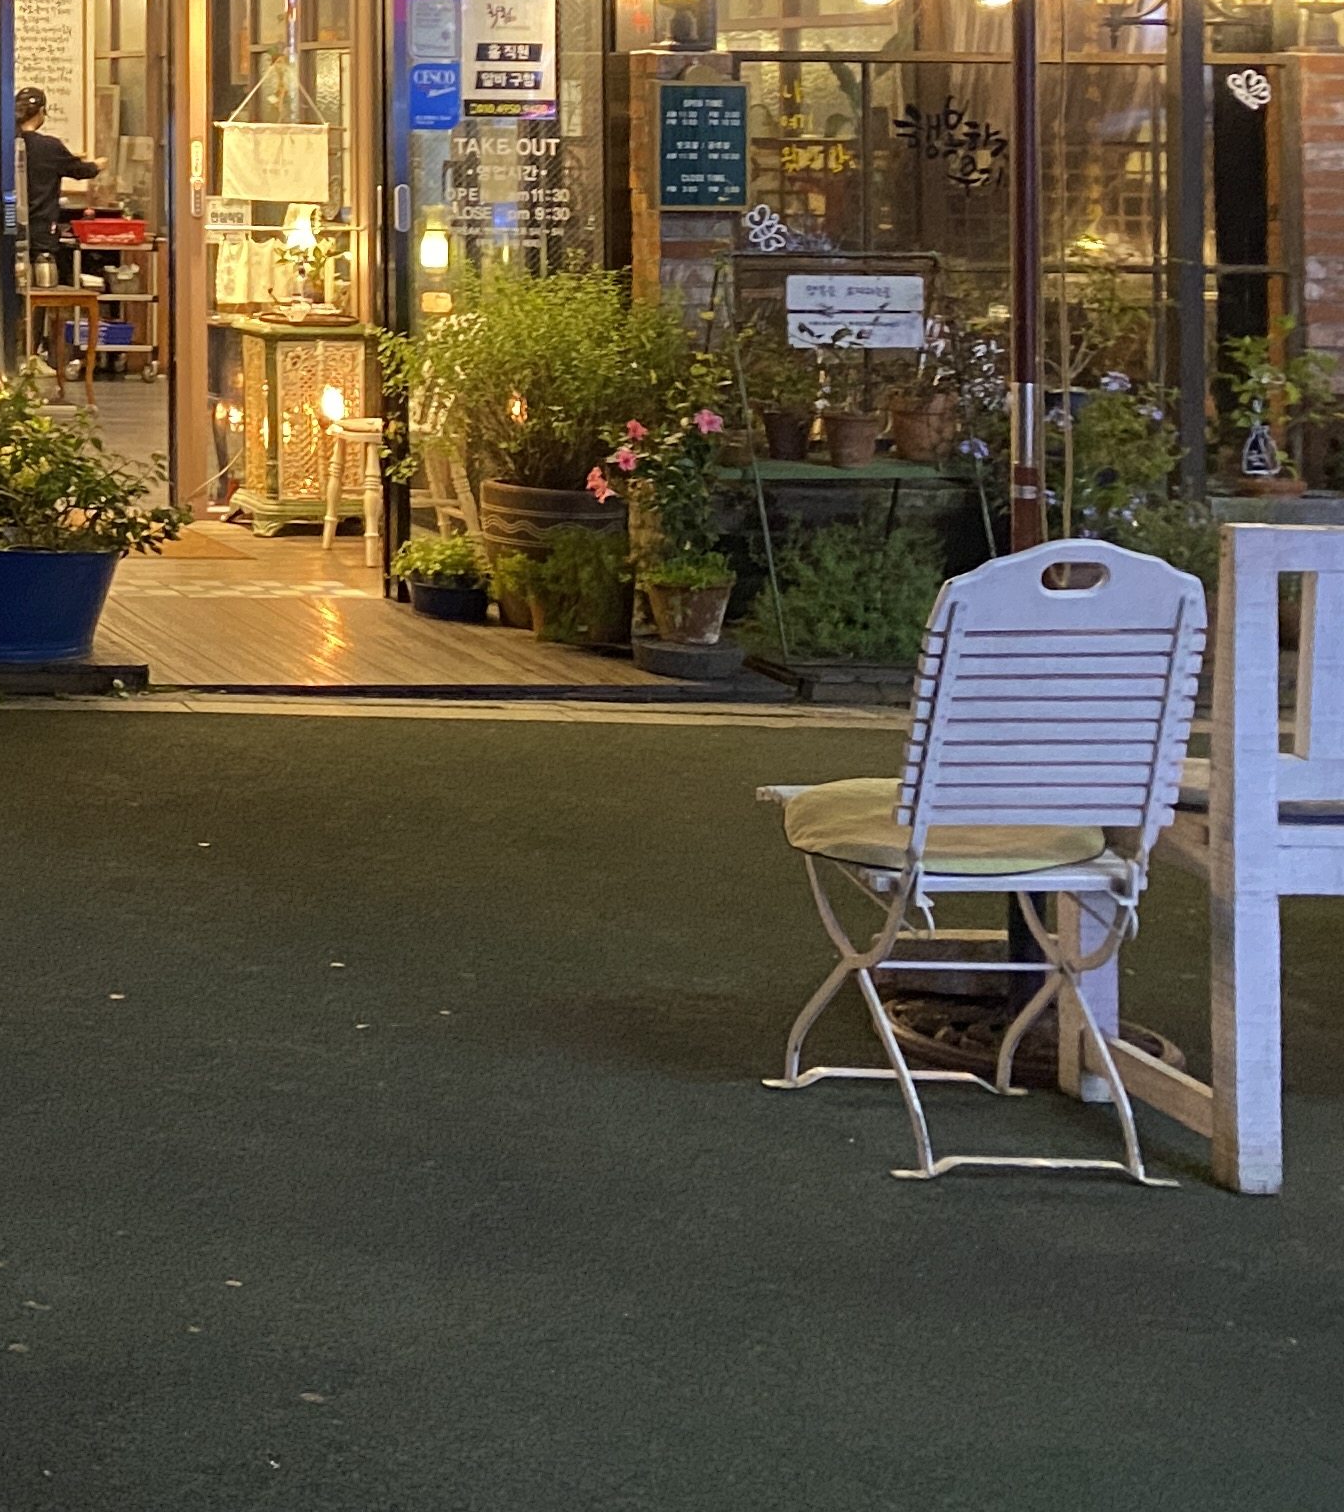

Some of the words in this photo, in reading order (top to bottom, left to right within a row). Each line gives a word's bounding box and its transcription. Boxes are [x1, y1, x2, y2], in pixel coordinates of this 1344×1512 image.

[413, 69, 456, 85] CESCO
[452, 137, 513, 156] TAKE
[516, 137, 561, 157] OUT
[530, 187, 571, 203] 11:30
[534, 206, 571, 221] 9:30
